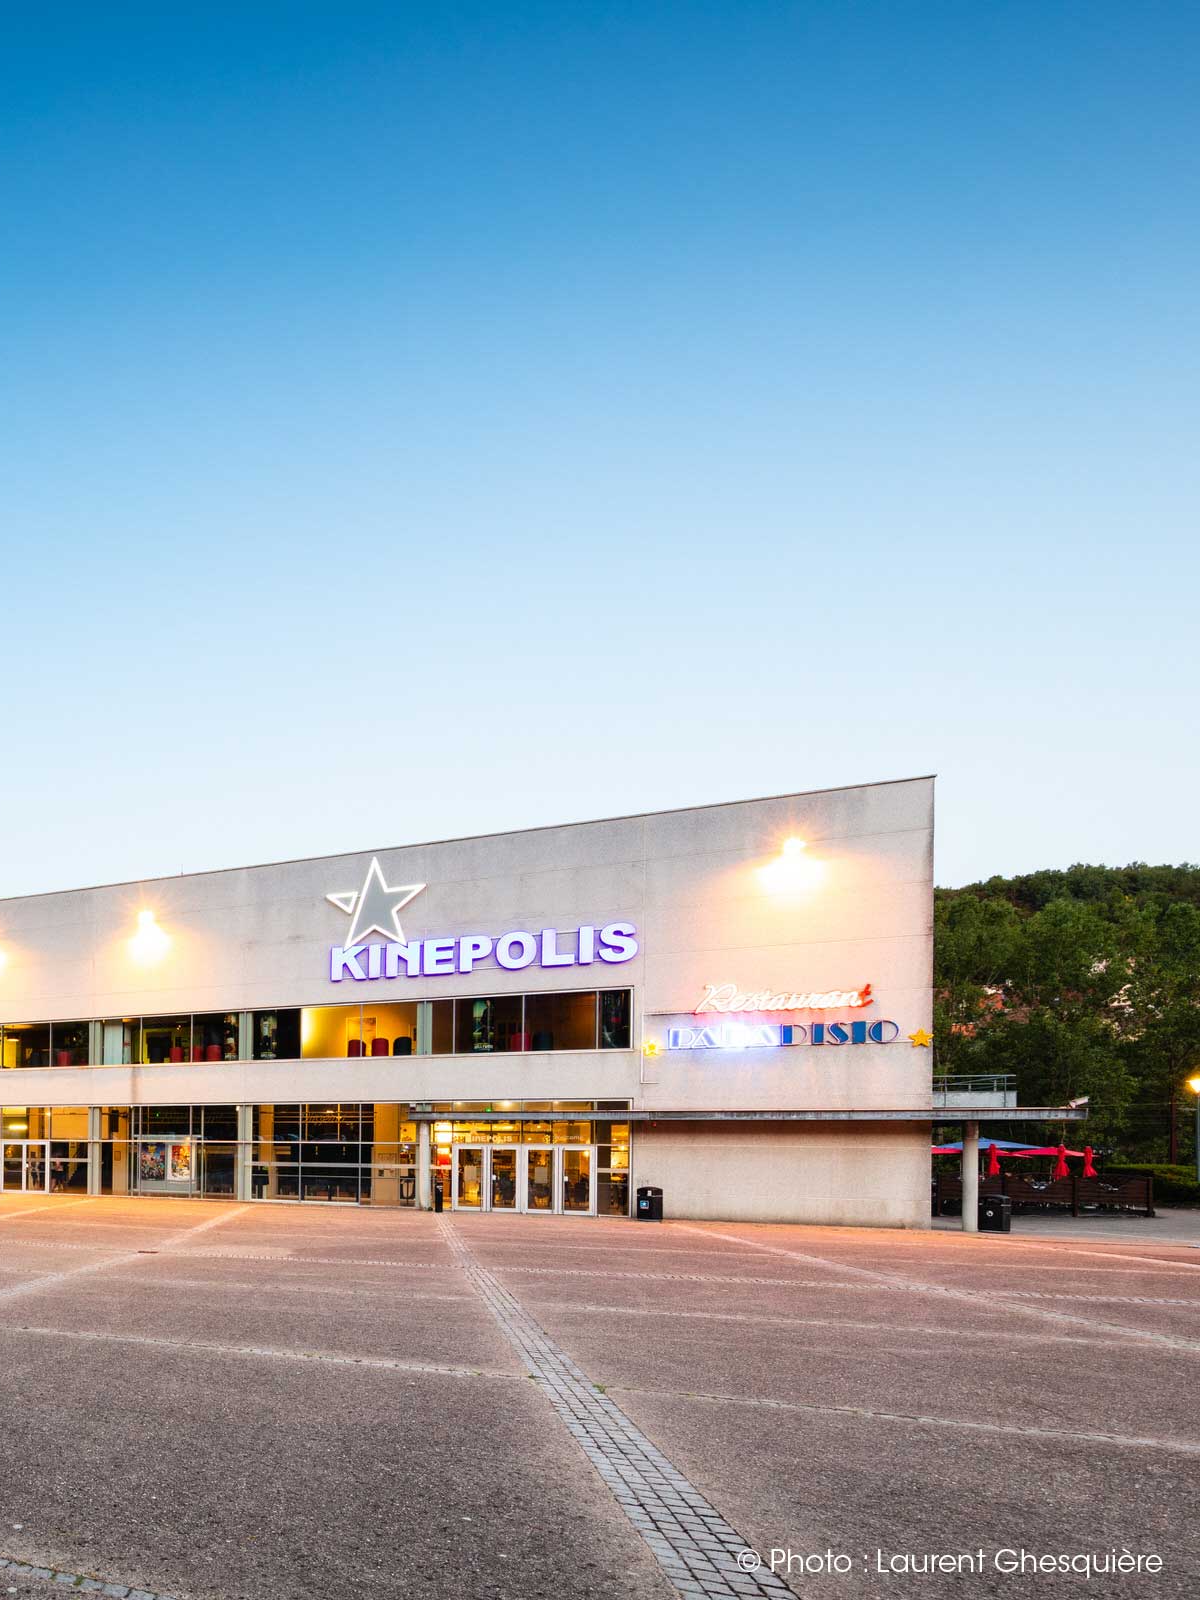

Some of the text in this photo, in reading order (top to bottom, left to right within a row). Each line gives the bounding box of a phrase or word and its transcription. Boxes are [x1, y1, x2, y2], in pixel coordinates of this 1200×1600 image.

[330, 922, 639, 982] KINEPOLIS
[695, 983, 874, 1014] Restaurant
[669, 1020, 899, 1050] PAADISIO
